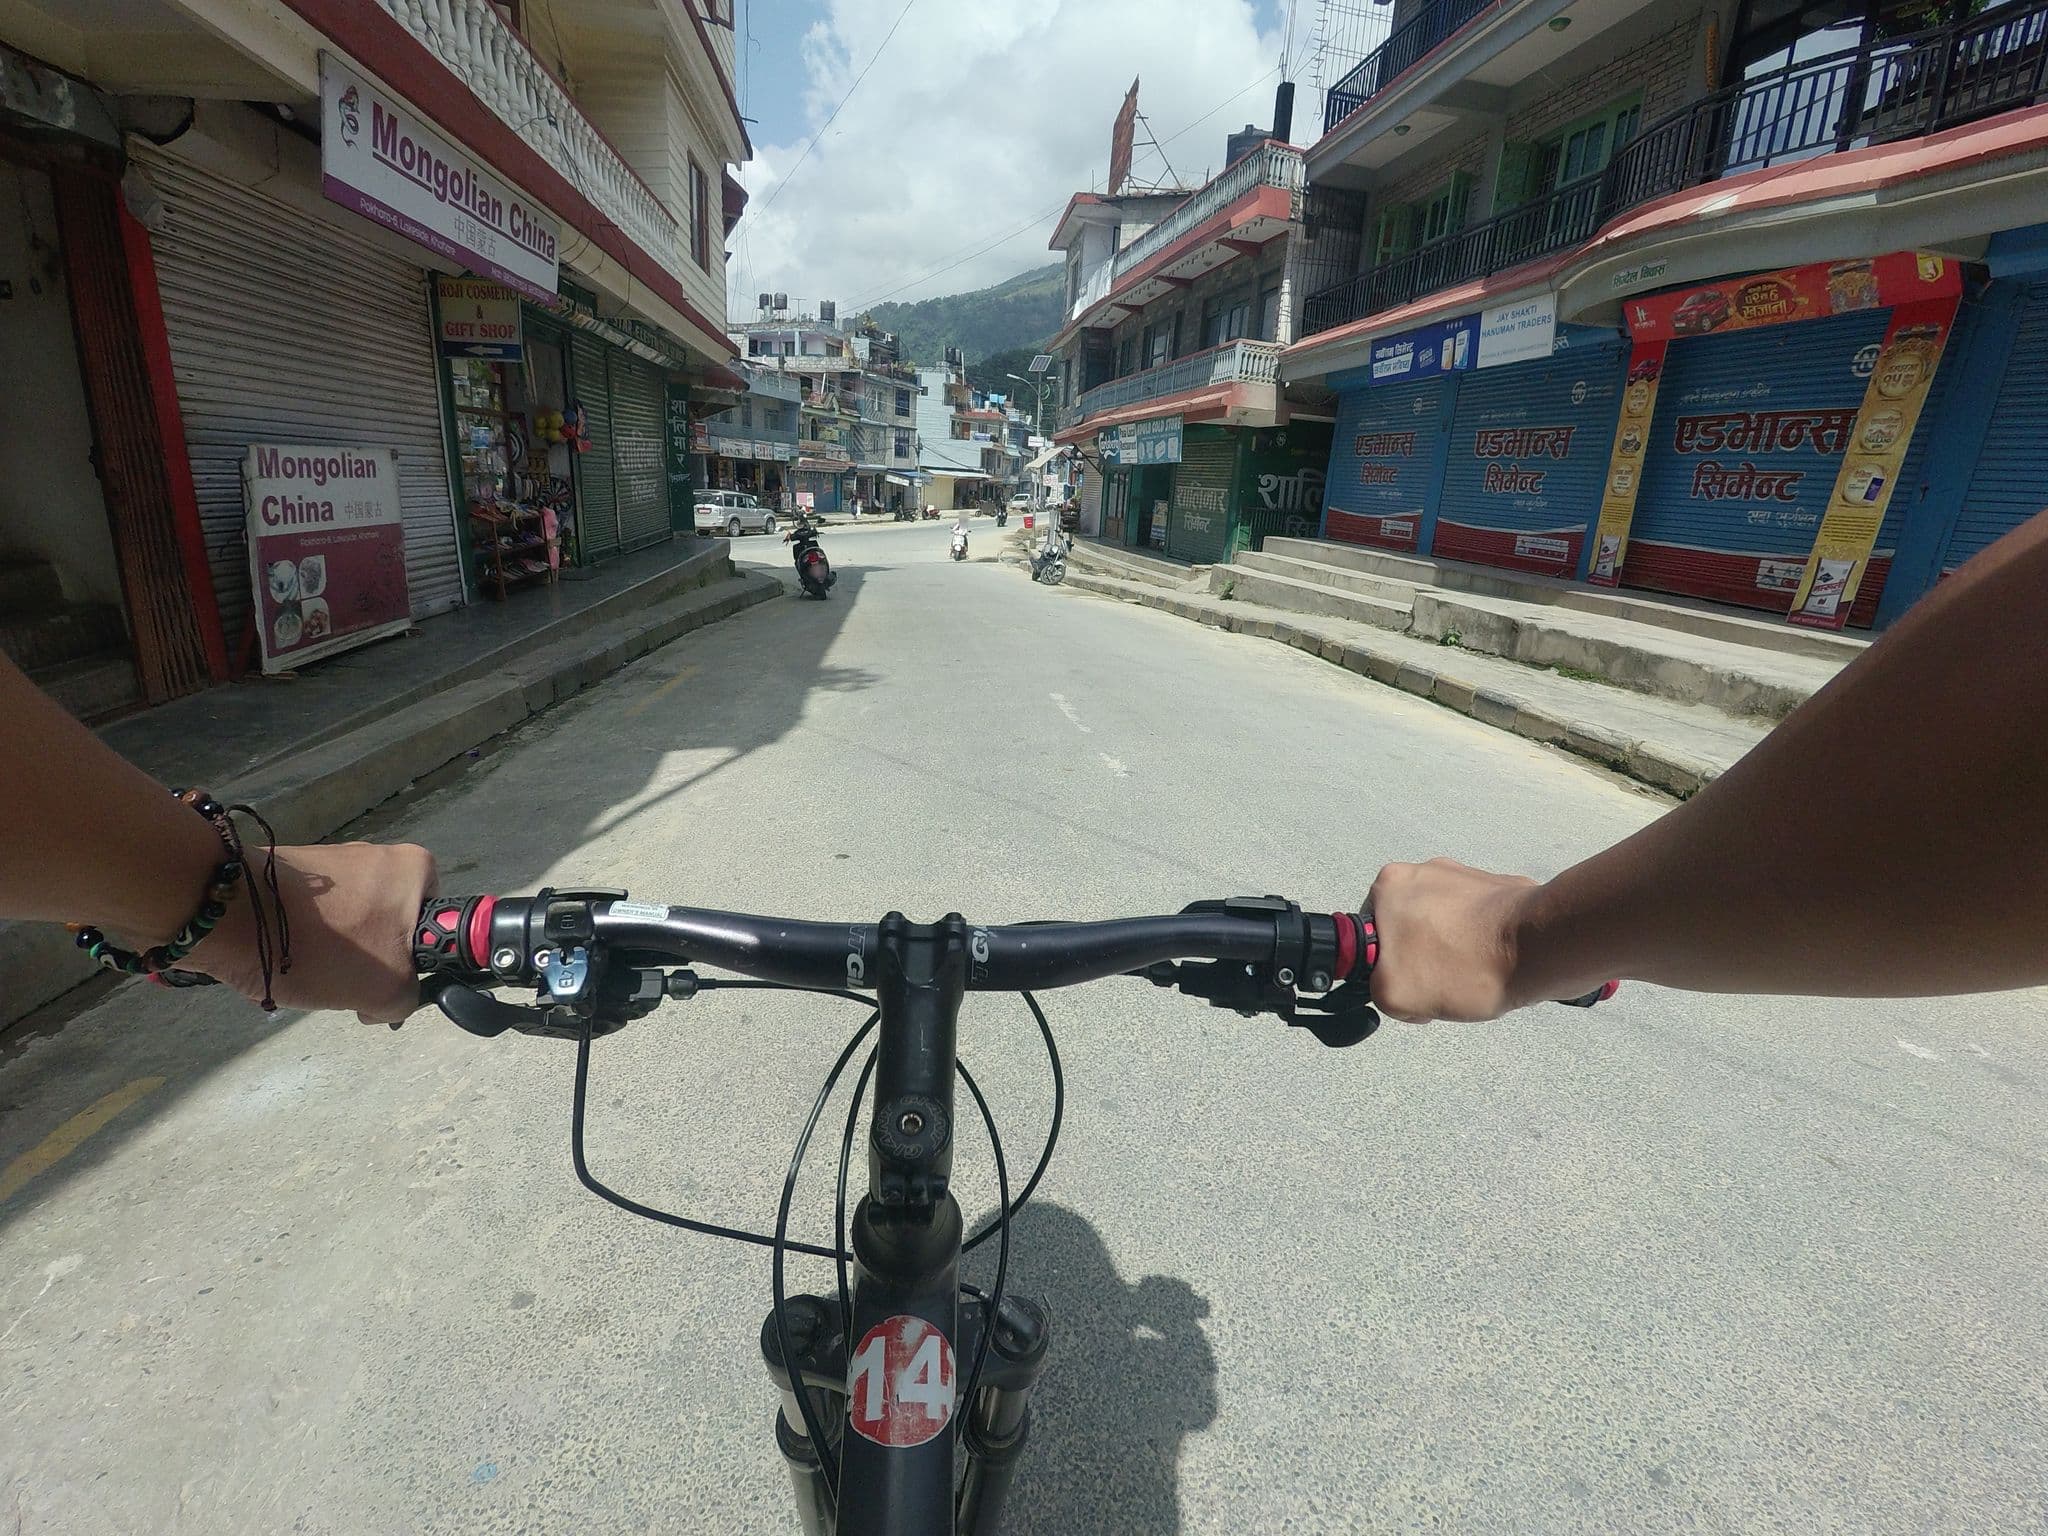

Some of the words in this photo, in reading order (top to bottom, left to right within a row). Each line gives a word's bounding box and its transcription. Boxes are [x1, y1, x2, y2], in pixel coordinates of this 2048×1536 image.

[372, 101, 503, 227] Mongolian
[509, 202, 556, 260] China
[476, 305, 483, 319] &
[1482, 323, 1516, 339] HANUMAN
[1517, 314, 1552, 331] TRADERS
[1496, 312, 1510, 323] JAY
[1510, 304, 1538, 320] SHAKTI
[445, 323, 475, 339] GIFT
[479, 323, 516, 339] SHOP
[257, 447, 377, 486] Mongolian
[1482, 461, 1547, 496] सिमेन्ट
[1691, 460, 1807, 502] सिमेन्ट
[261, 495, 334, 527] China
[850, 1336, 948, 1421] 14
